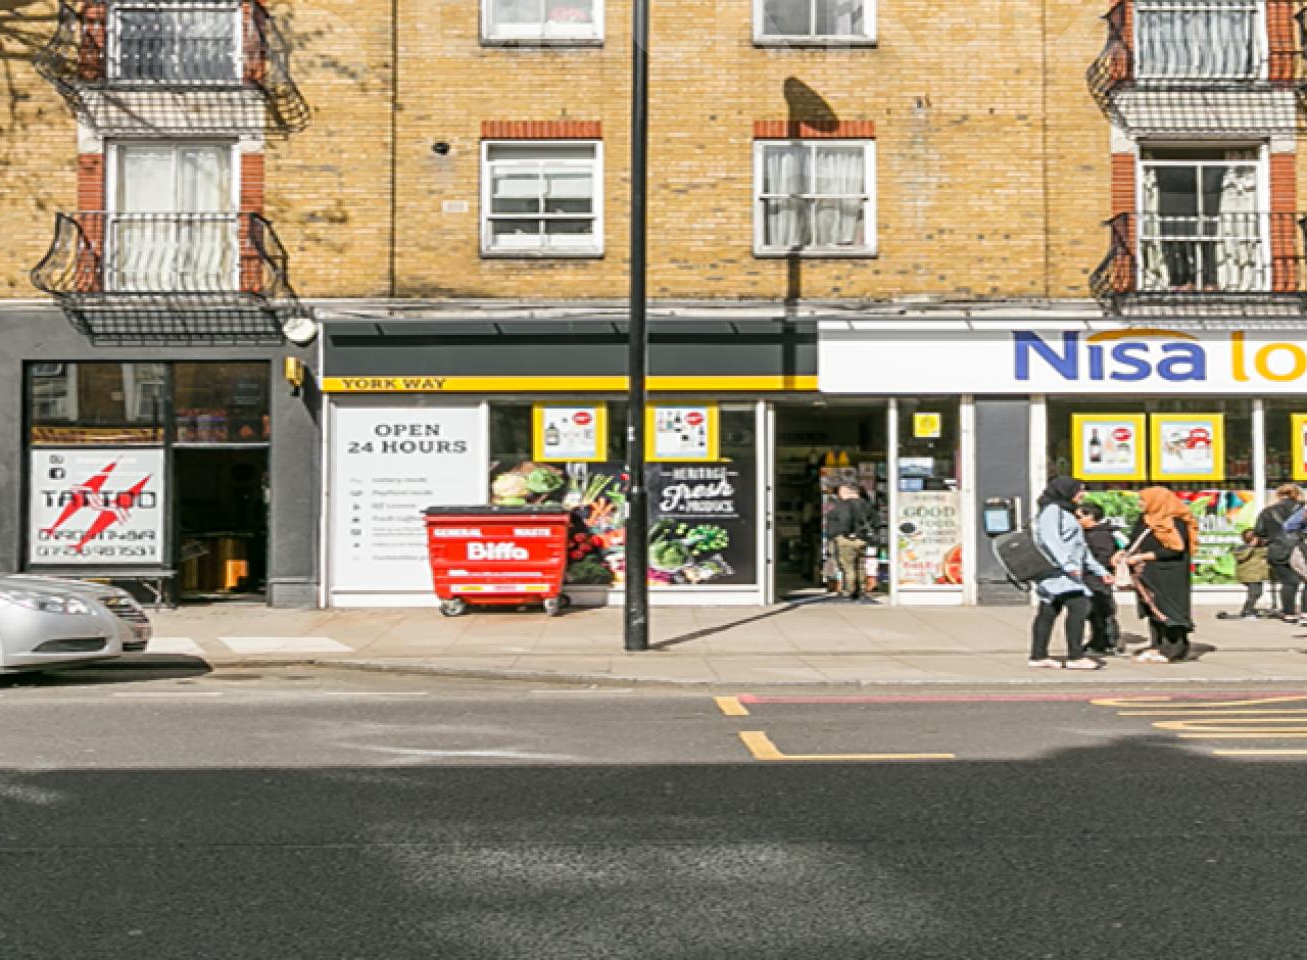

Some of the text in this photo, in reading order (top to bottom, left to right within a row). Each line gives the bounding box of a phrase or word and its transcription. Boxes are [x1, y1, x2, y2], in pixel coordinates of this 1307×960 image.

[1012, 328, 1206, 382] Nisa
[342, 378, 446, 389] YORK WAY
[373, 423, 441, 437] OPEN
[348, 440, 468, 455] 24 HOURS
[40, 489, 157, 509] TATTOO
[467, 541, 530, 560] Biffa
